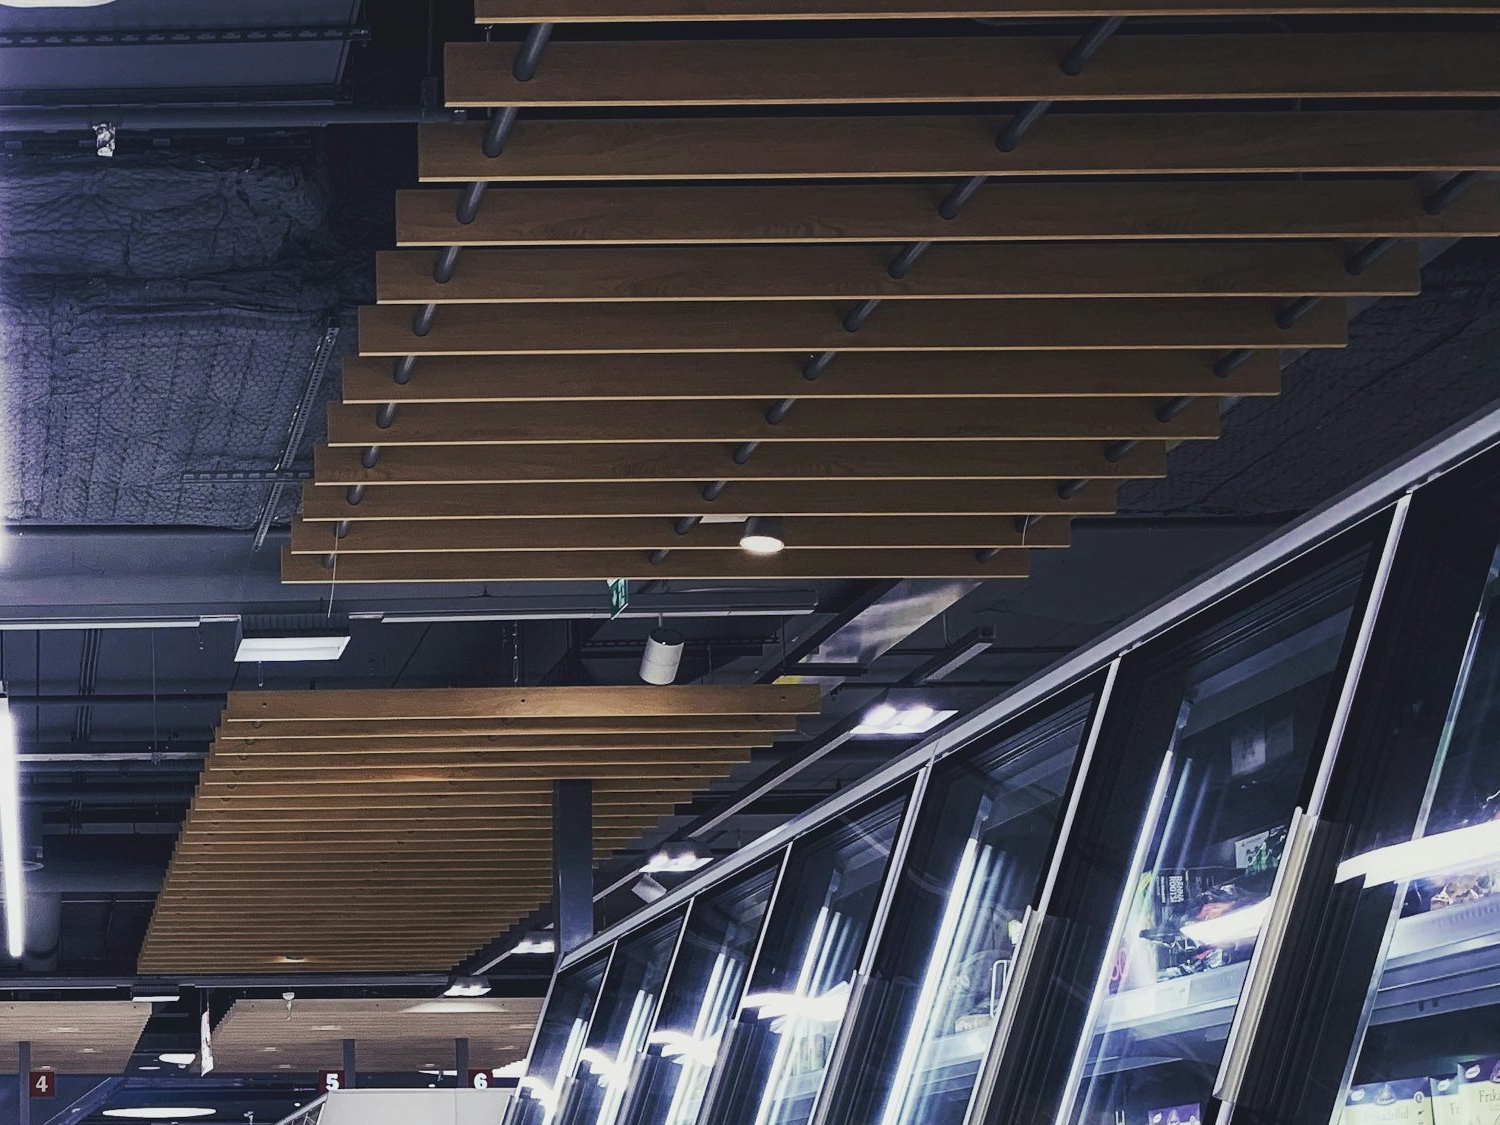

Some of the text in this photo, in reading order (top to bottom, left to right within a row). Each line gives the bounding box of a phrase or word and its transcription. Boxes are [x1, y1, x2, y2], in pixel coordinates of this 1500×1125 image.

[35, 1075, 49, 1093] 4
[325, 1073, 340, 1091] 5
[473, 1072, 488, 1090] 6
